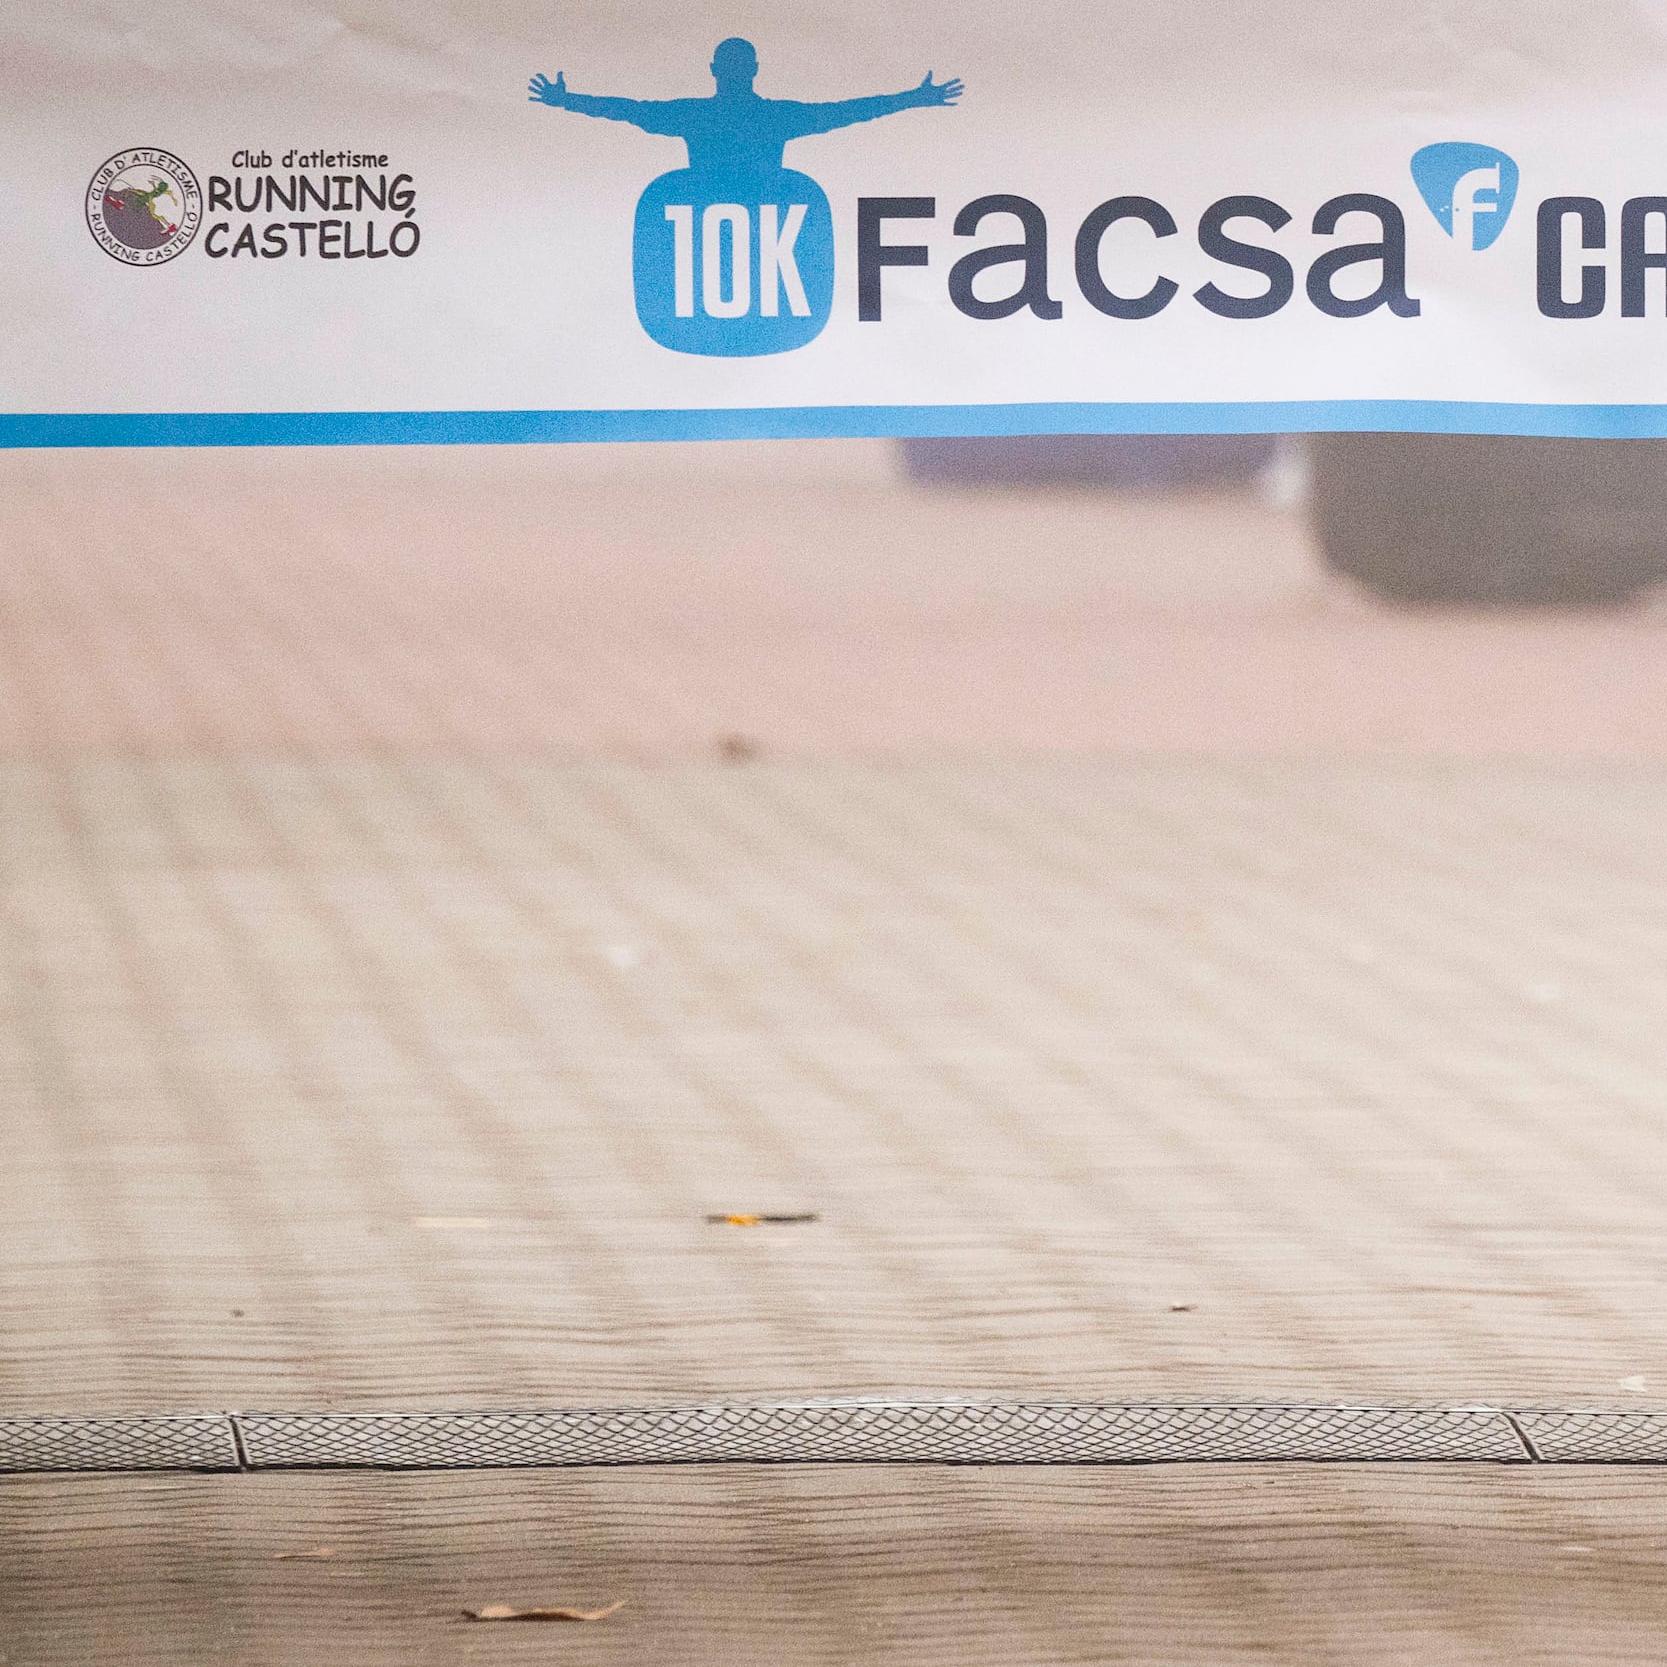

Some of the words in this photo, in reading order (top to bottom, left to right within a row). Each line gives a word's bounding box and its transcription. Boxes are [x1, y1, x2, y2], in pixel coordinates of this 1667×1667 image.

[231, 149, 273, 169] Club
[281, 149, 389, 169] d'atletisme
[92, 168, 114, 201] CLUB
[208, 174, 417, 213] RUNNING
[91, 213, 140, 262] RUNNING
[204, 207, 421, 259] CASTELLÓ
[664, 202, 811, 319] 10K
[857, 192, 1421, 322] Facsa
